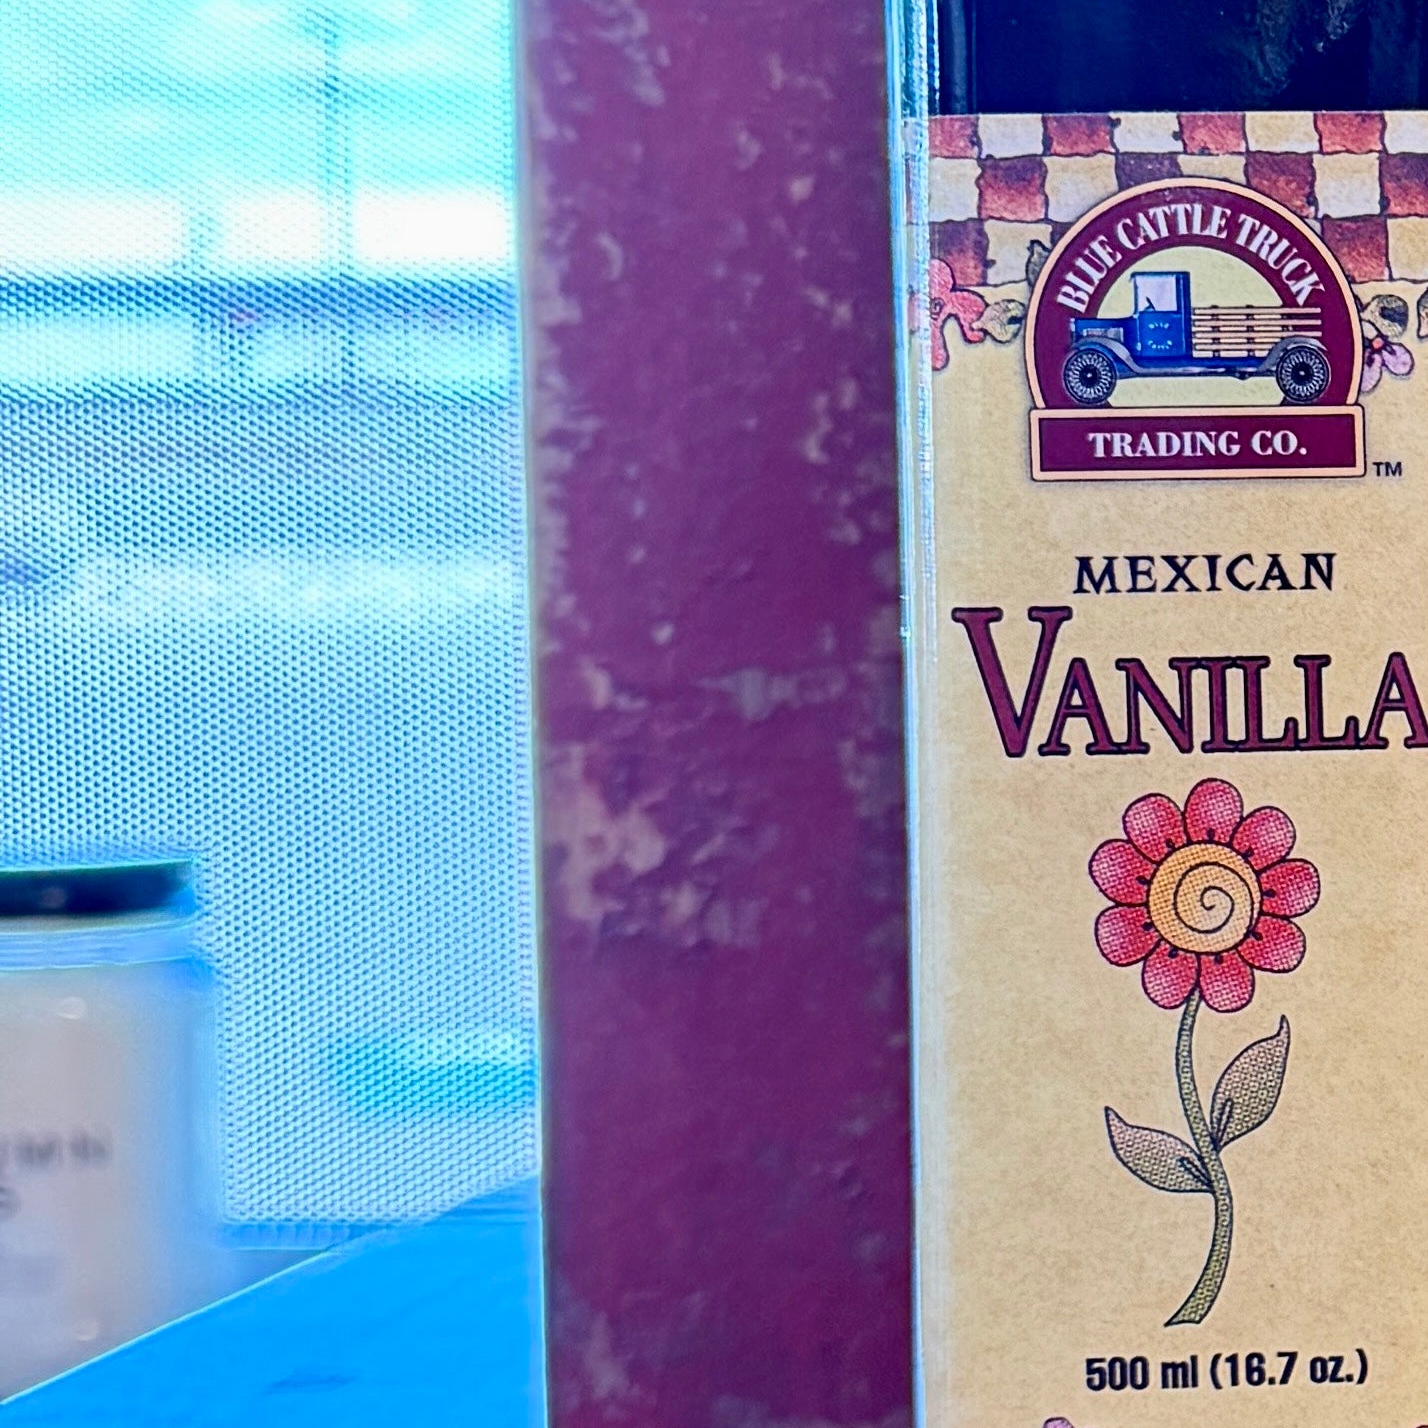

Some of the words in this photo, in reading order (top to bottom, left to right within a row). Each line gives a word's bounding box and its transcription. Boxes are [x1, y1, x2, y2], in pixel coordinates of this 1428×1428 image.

[1056, 234, 1122, 314] BLUE
[1115, 203, 1232, 251] CATTLE
[1234, 213, 1326, 307] TRUCK
[1087, 429, 1241, 458] TRADING
[1251, 427, 1308, 457] CO.
[1373, 460, 1403, 478] TM
[1072, 551, 1337, 595] MEXICAN
[1085, 1355, 1151, 1392] 500
[1160, 1354, 1199, 1390] ml
[1209, 1350, 1299, 1390] (16.7
[1308, 1347, 1369, 1386] oz.)
